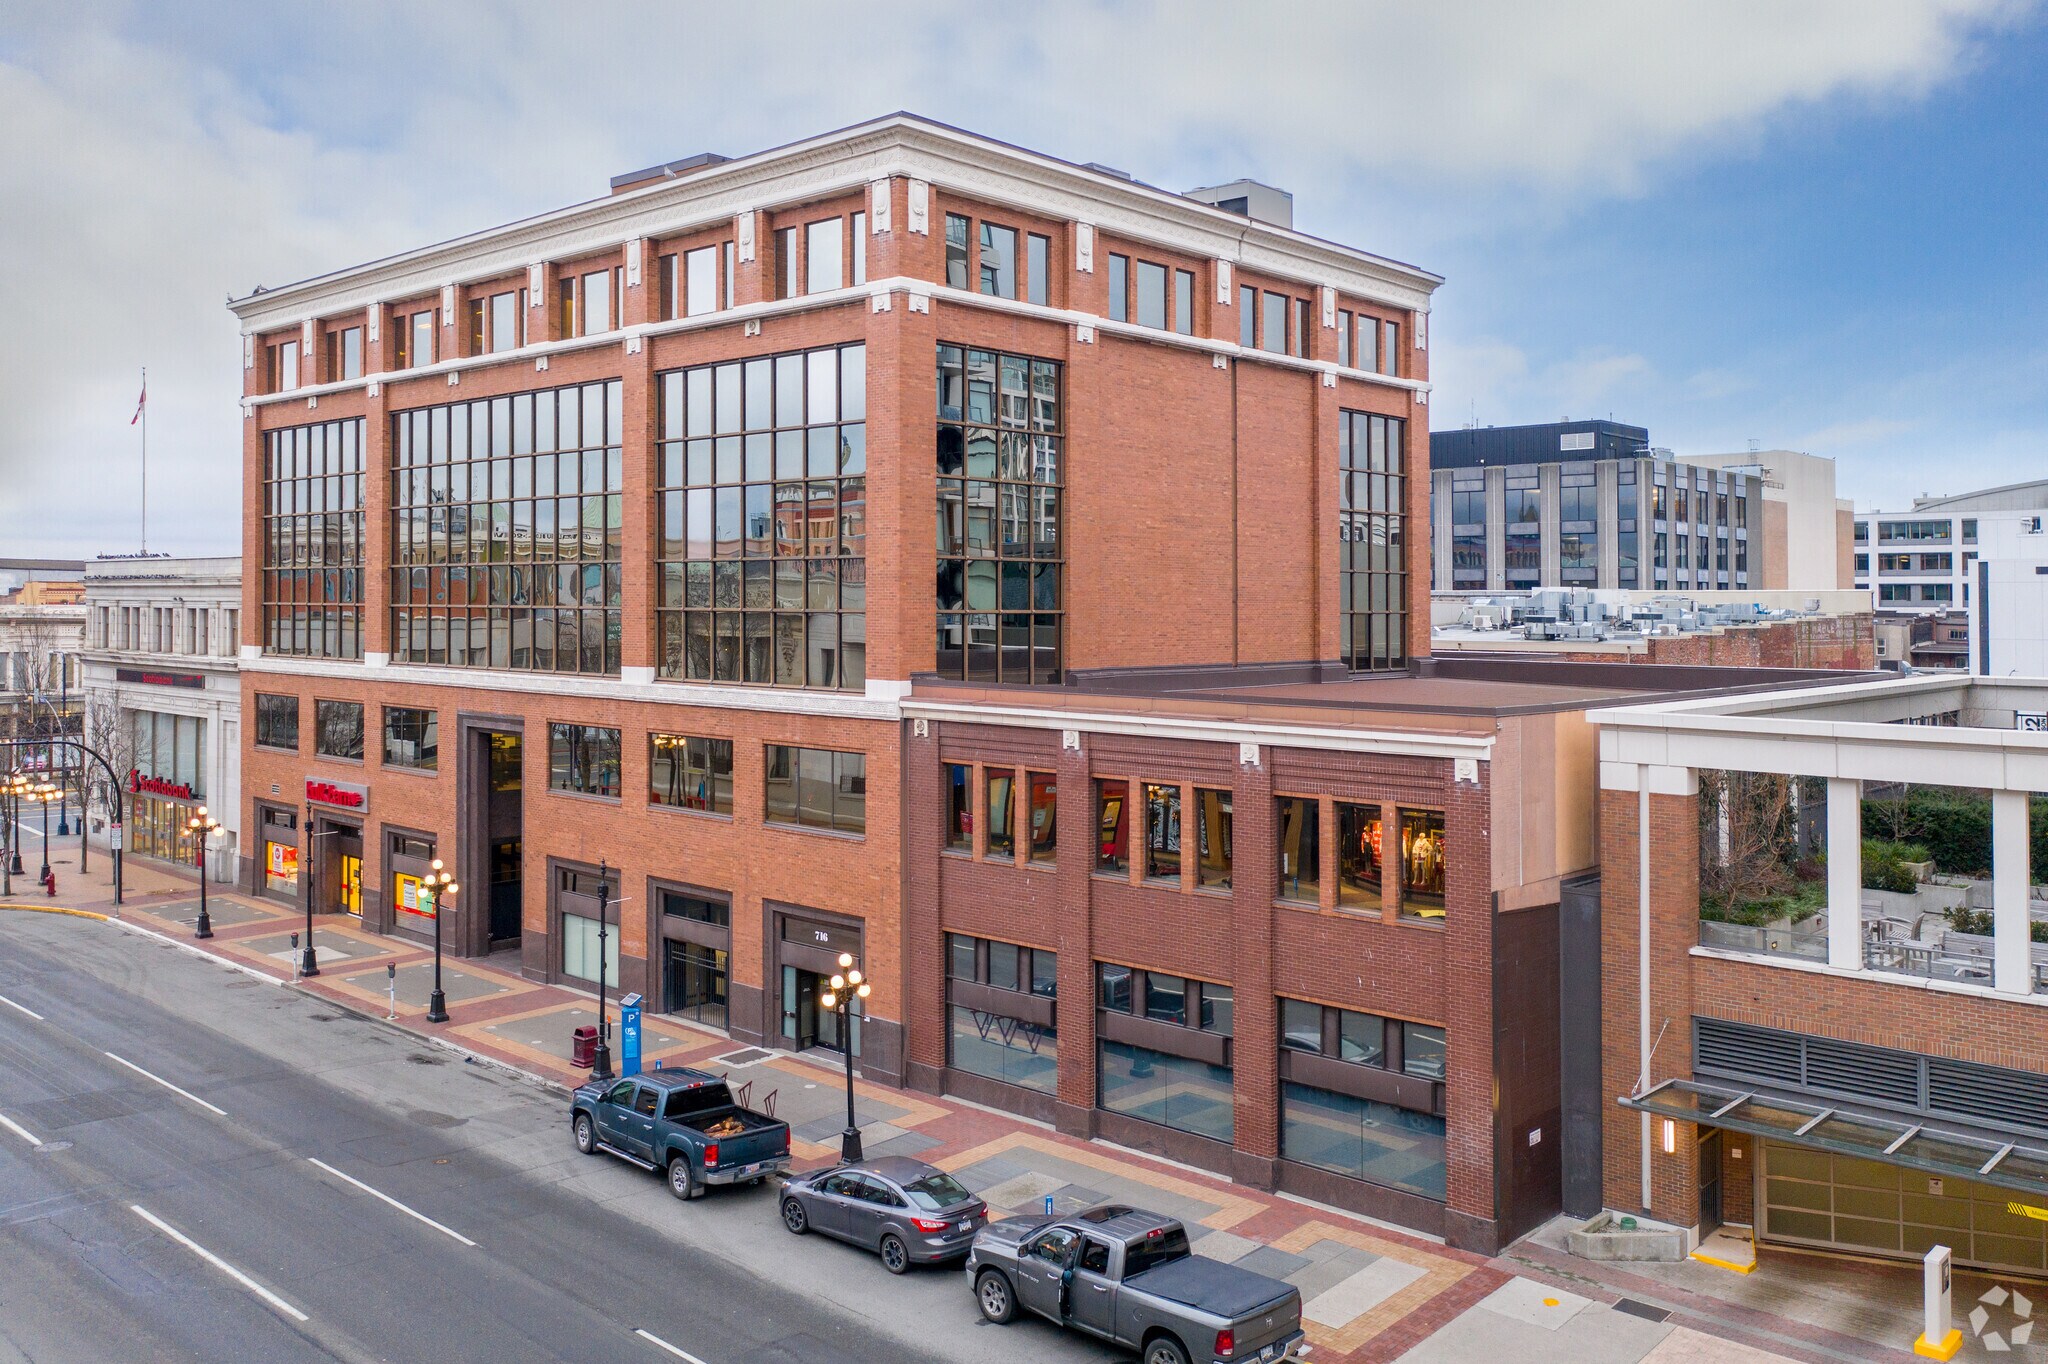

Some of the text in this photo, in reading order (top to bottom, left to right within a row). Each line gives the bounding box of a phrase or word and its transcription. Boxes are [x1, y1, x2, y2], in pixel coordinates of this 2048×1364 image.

[140, 774, 192, 801] Scotiabank
[814, 930, 829, 942] 716
[628, 1014, 635, 1023] P
